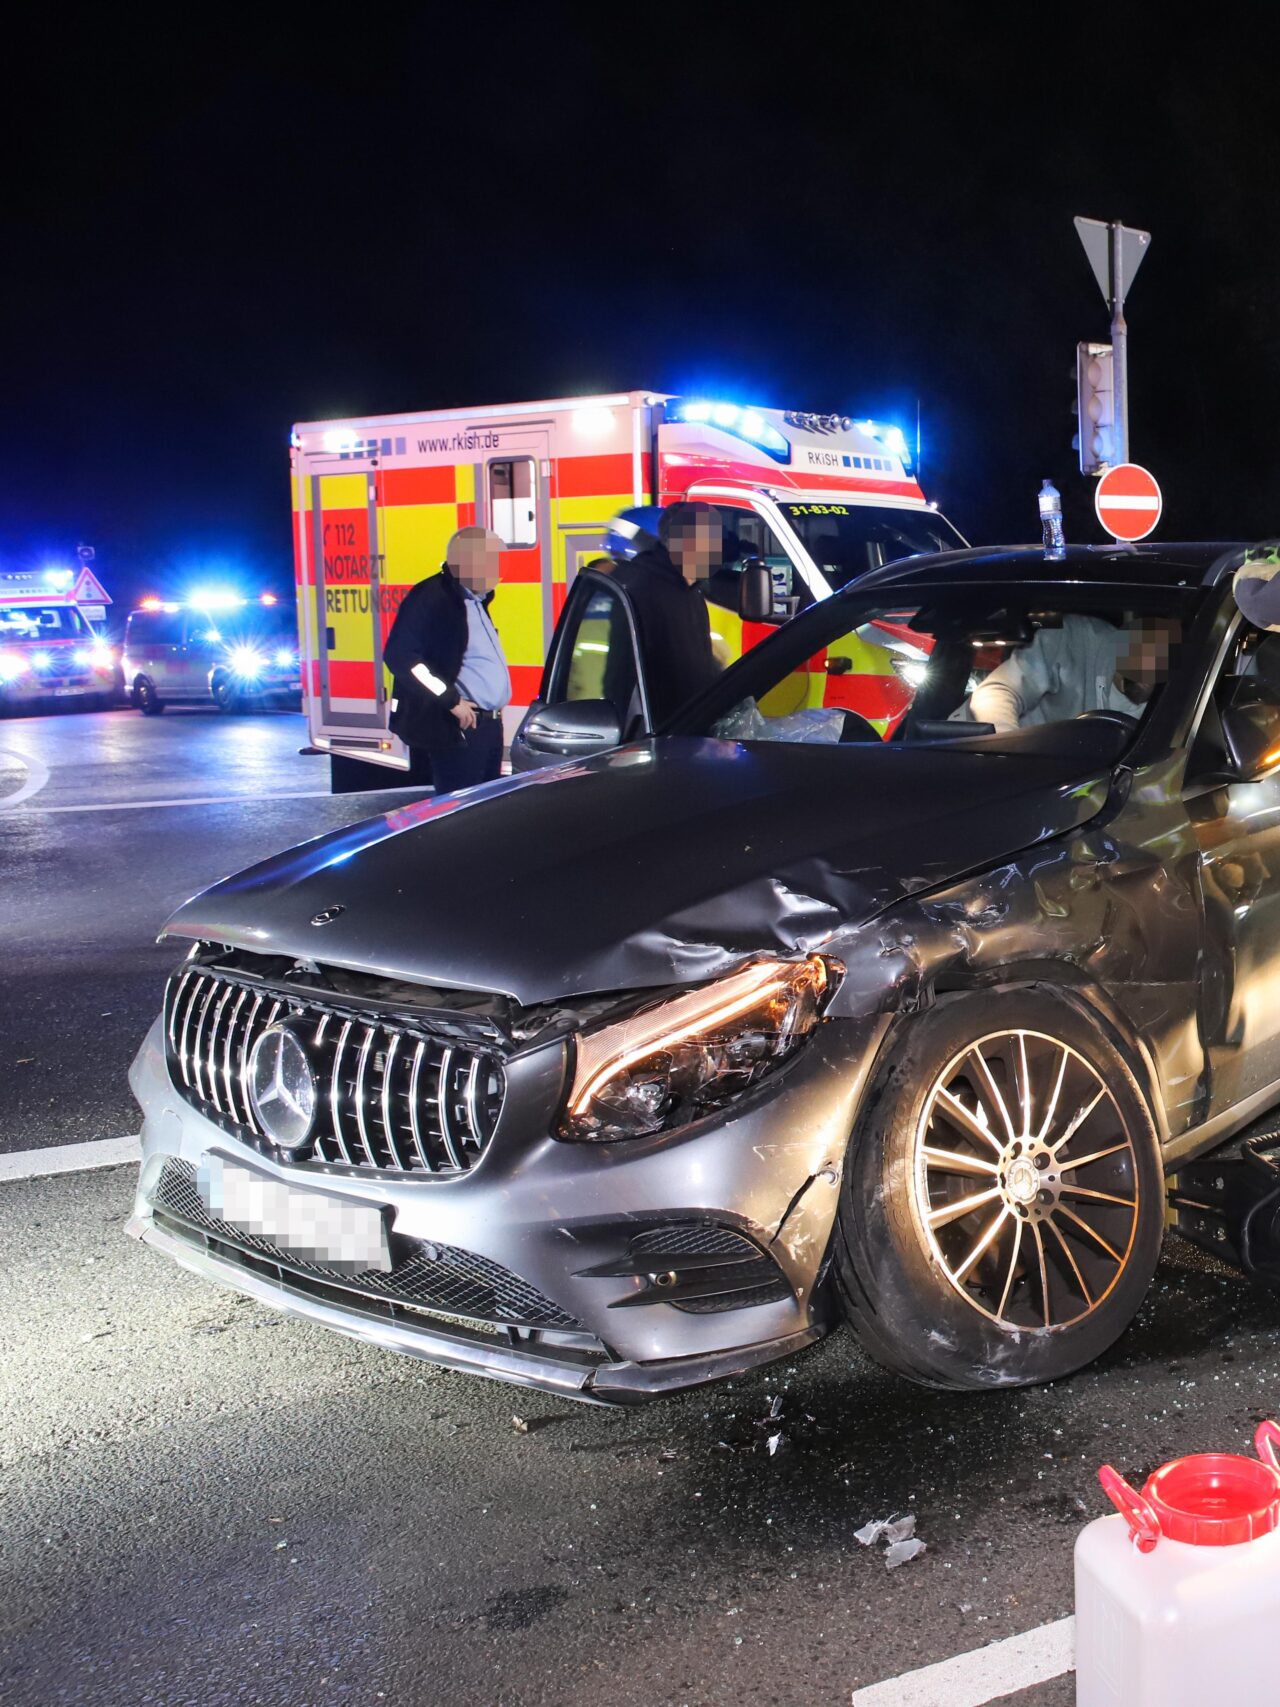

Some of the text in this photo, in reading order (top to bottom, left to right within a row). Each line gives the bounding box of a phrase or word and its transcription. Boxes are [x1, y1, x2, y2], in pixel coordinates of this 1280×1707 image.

[417, 431, 500, 454] www.rkish.de
[788, 505, 850, 517] 31-83-02
[335, 522, 356, 546] 112
[324, 554, 385, 580] NOTARZT
